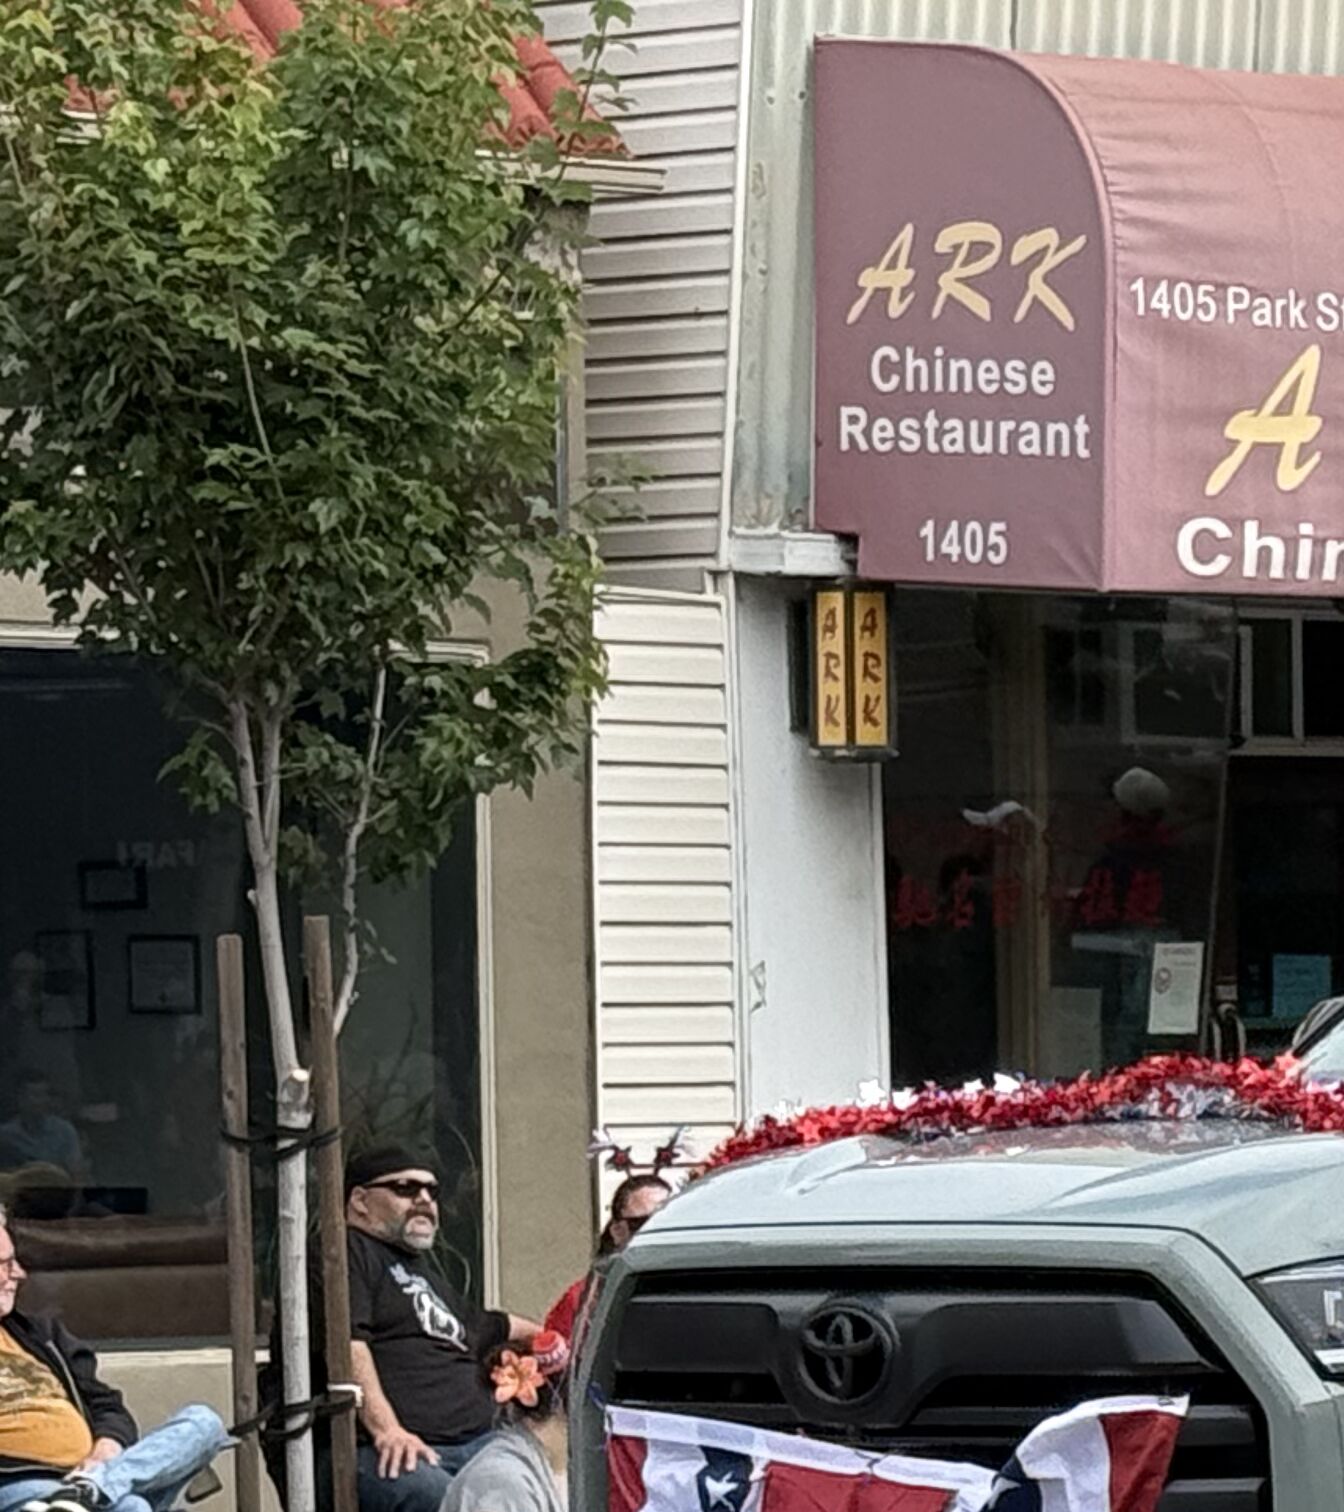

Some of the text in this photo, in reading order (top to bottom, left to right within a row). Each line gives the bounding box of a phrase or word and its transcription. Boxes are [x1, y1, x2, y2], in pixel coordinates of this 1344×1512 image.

[846, 220, 1088, 331] ARK
[1130, 279, 1216, 322] 1405
[1226, 293, 1308, 331] Park
[870, 347, 1055, 396] Chinese
[839, 407, 1091, 458] Restaurant
[919, 521, 1008, 566] 1405
[822, 607, 841, 728] ARK
[859, 607, 882, 728] ARK
